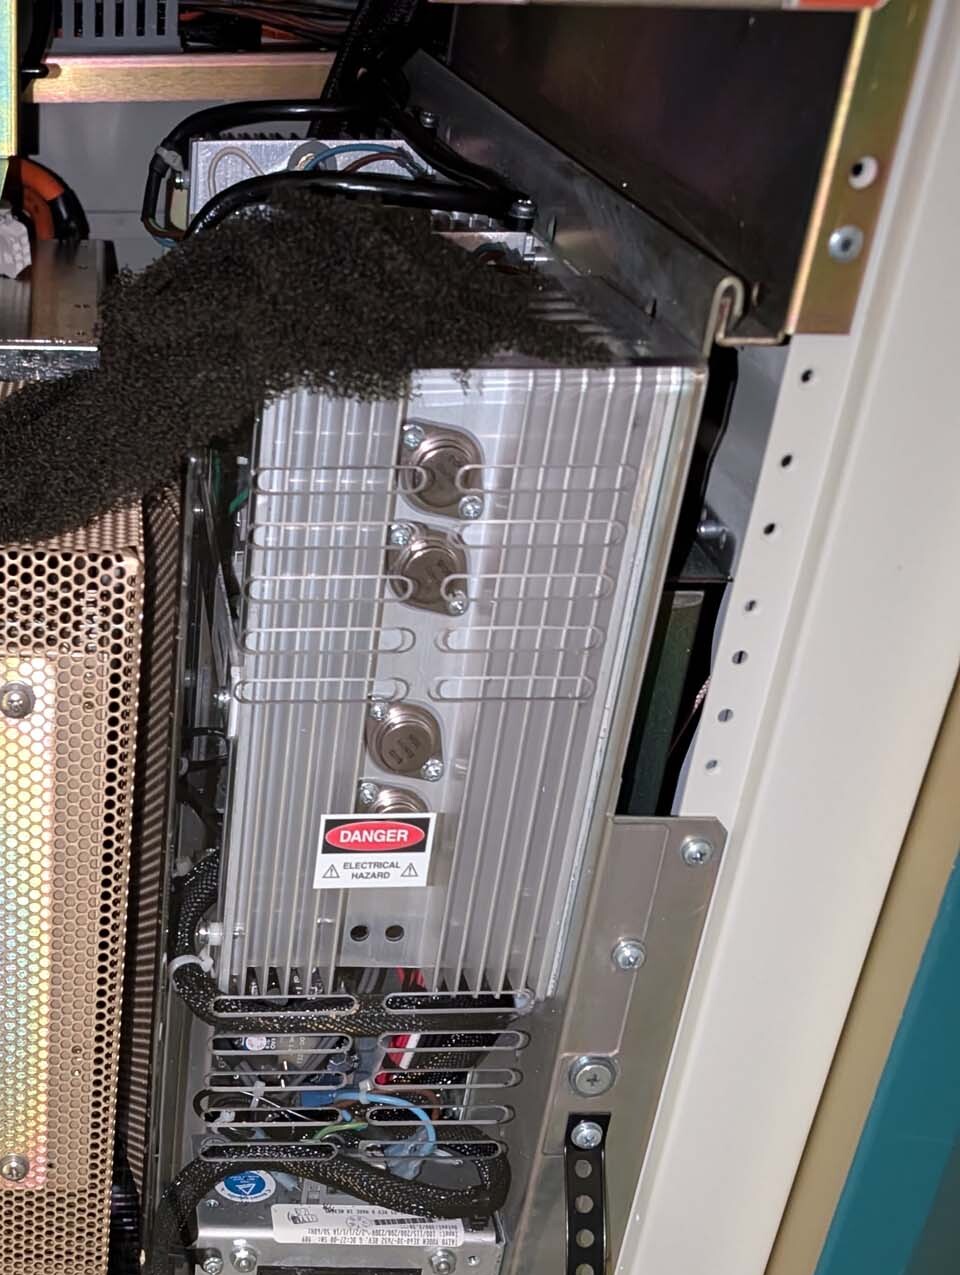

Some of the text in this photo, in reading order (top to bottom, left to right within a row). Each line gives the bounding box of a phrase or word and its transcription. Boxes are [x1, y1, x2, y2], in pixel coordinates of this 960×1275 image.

[339, 829, 409, 843] DANGER
[342, 861, 401, 870] ELECTRICAL
[351, 871, 391, 880] HAZARD
